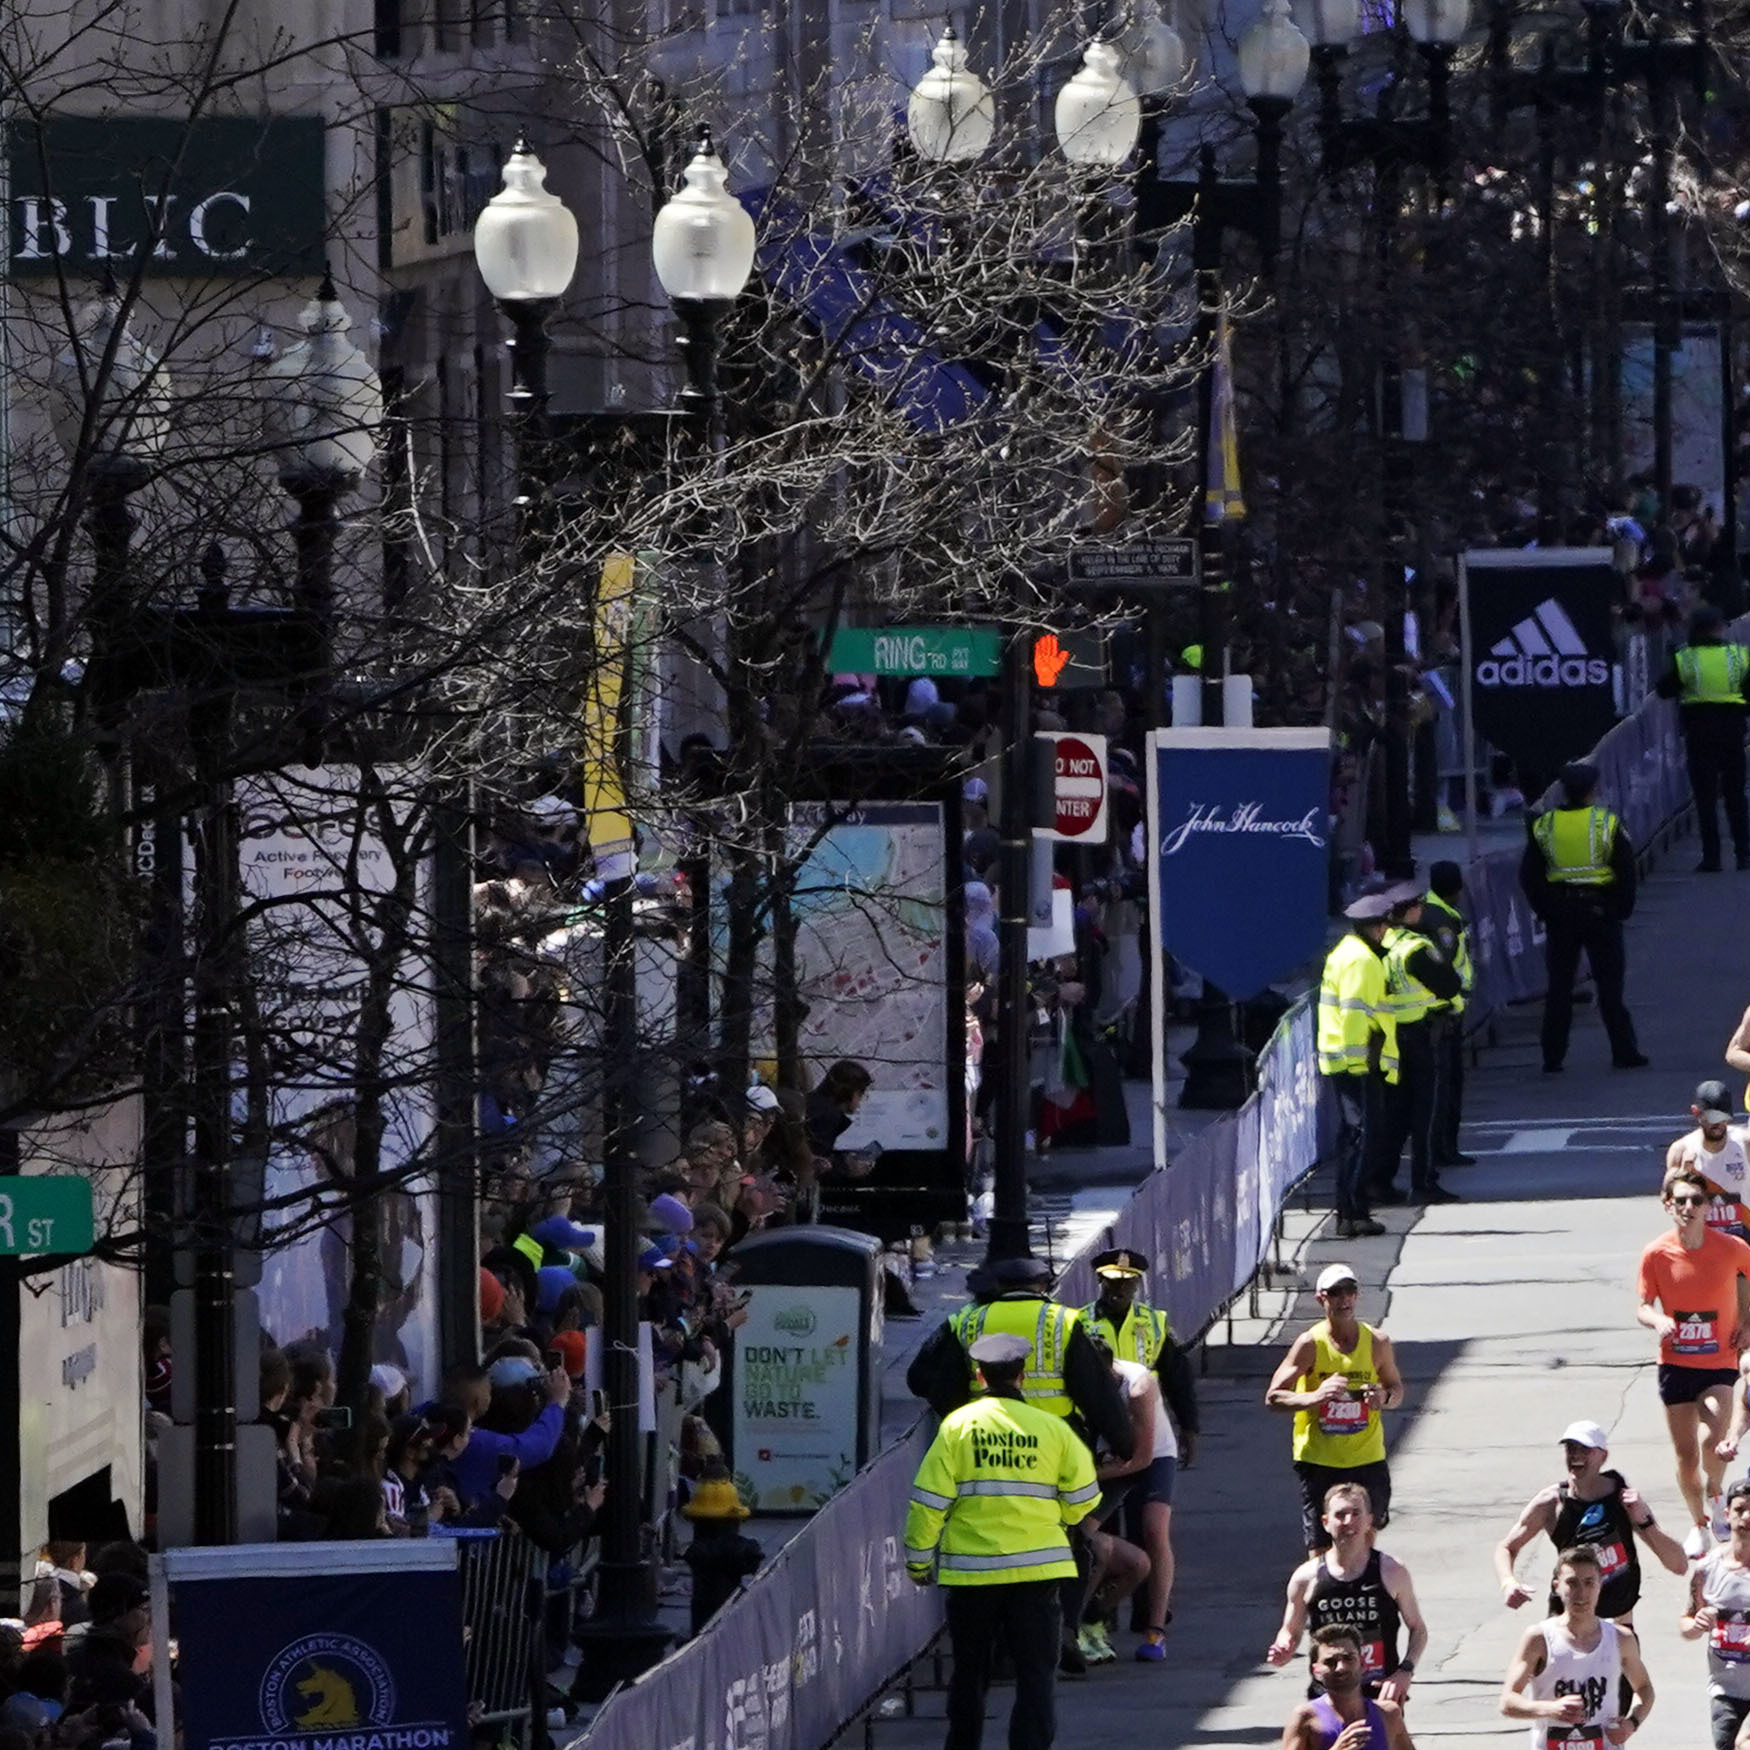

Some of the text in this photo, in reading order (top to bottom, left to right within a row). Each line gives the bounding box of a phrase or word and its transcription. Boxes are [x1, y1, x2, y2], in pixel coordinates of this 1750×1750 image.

[875, 636, 926, 670] RING
[1477, 655, 1609, 686] adidas
[1070, 758, 1094, 775] NOT
[1056, 800, 1089, 818] NTER
[1161, 802, 1328, 855] John Hancock
[28, 1219, 55, 1247] ST
[744, 1346, 805, 1364] DON'T
[743, 1401, 821, 1419] WASTE.
[975, 1447, 1038, 1471] Police
[1318, 1598, 1377, 1612] GOOSE
[1321, 1610, 1379, 1622] ISLAND
